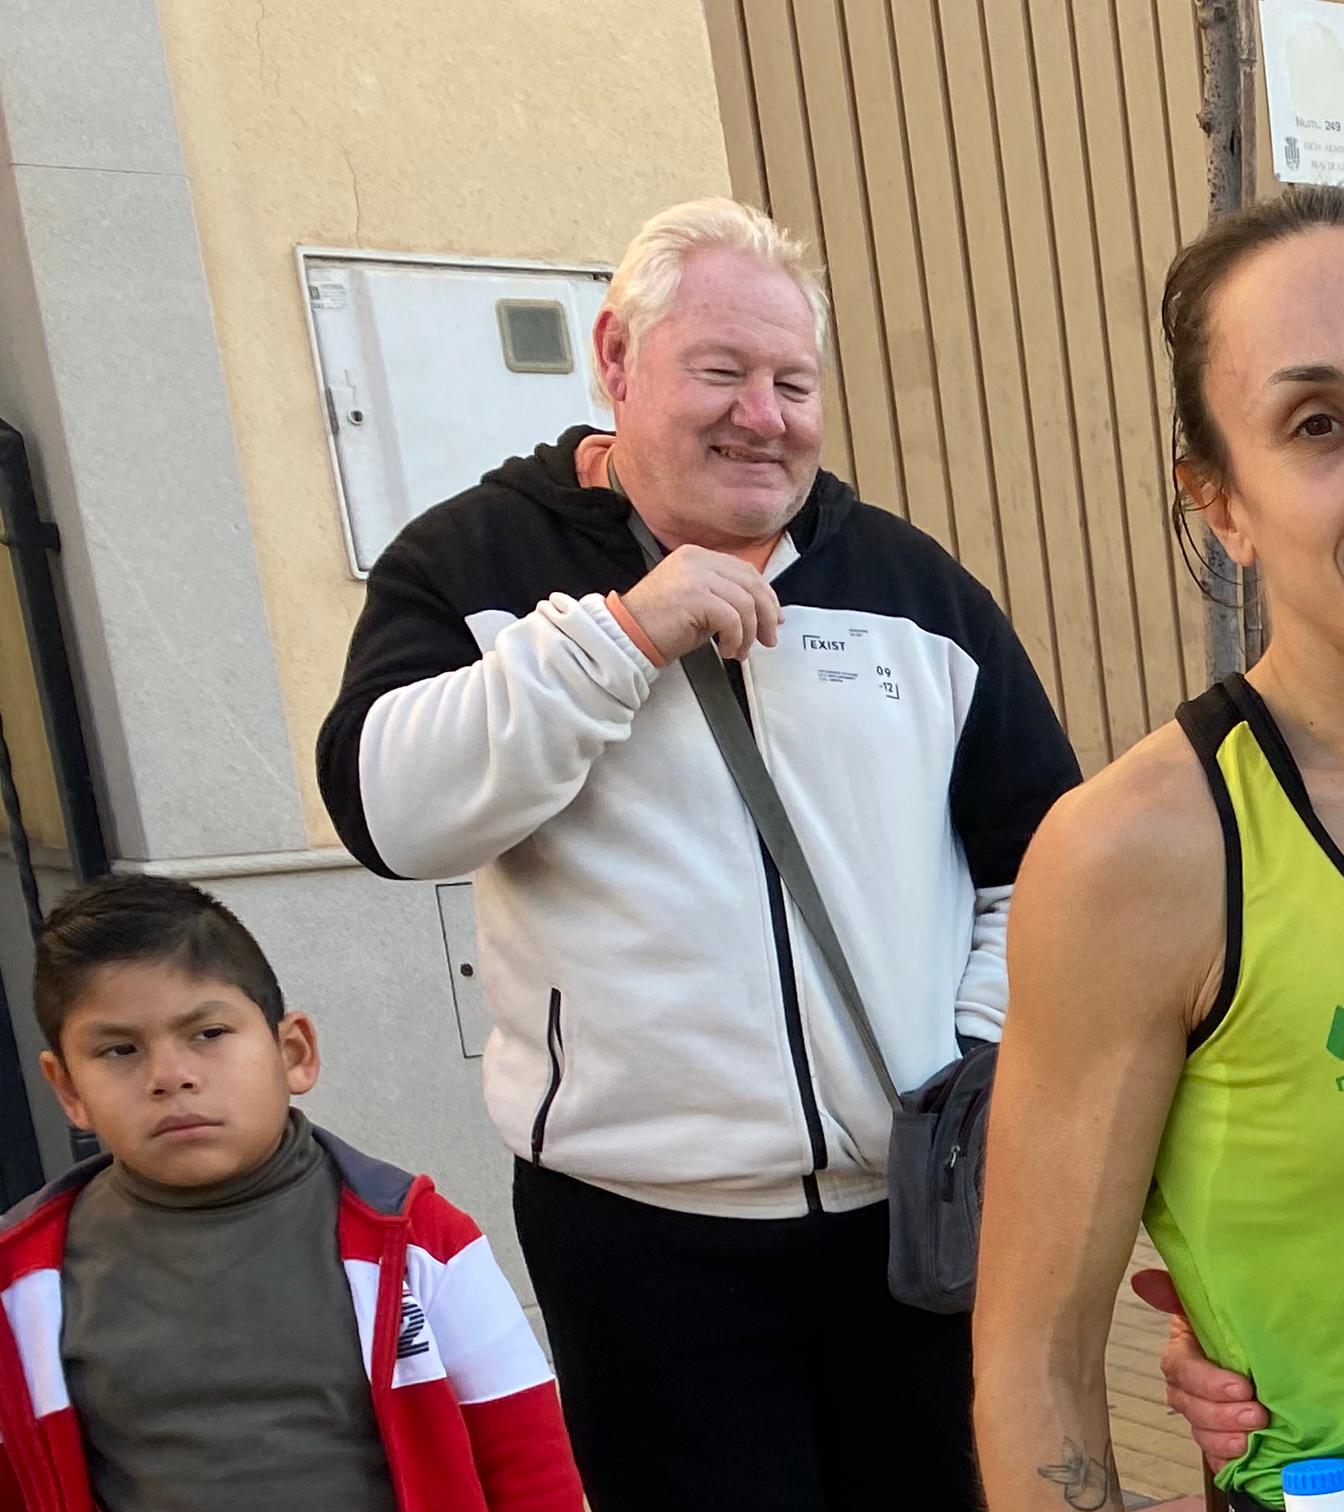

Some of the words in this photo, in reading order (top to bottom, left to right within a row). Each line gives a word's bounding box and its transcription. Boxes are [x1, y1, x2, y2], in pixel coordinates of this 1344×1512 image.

[1325, 120, 1341, 132] 249
[810, 640, 845, 651] EXIST
[876, 665, 891, 677] 09
